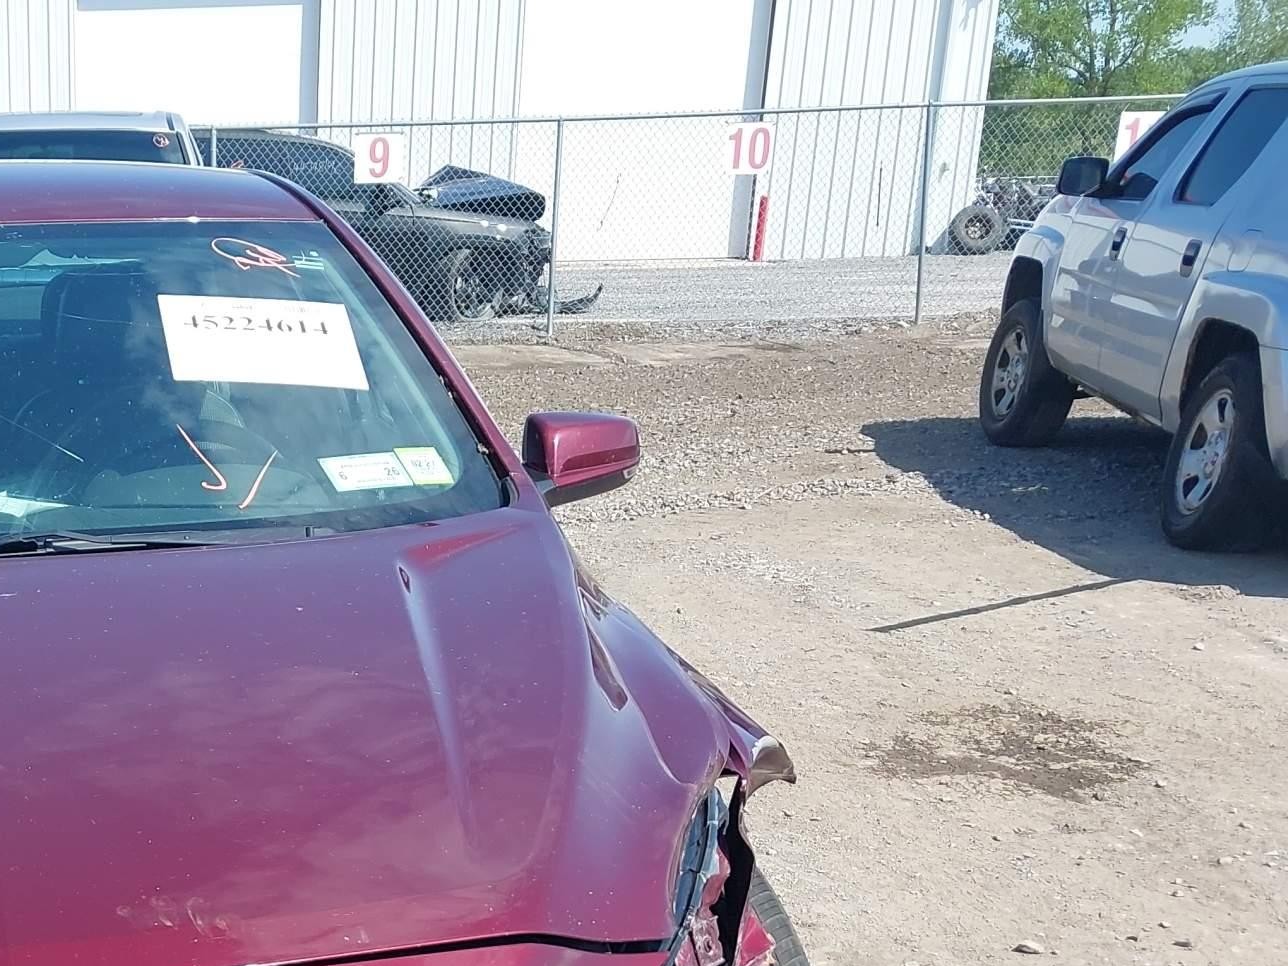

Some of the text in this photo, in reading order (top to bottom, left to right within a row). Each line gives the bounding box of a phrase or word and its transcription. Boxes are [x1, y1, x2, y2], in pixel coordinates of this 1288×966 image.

[368, 136, 390, 178] 9
[729, 127, 770, 169] 10
[184, 315, 328, 334] 45224614
